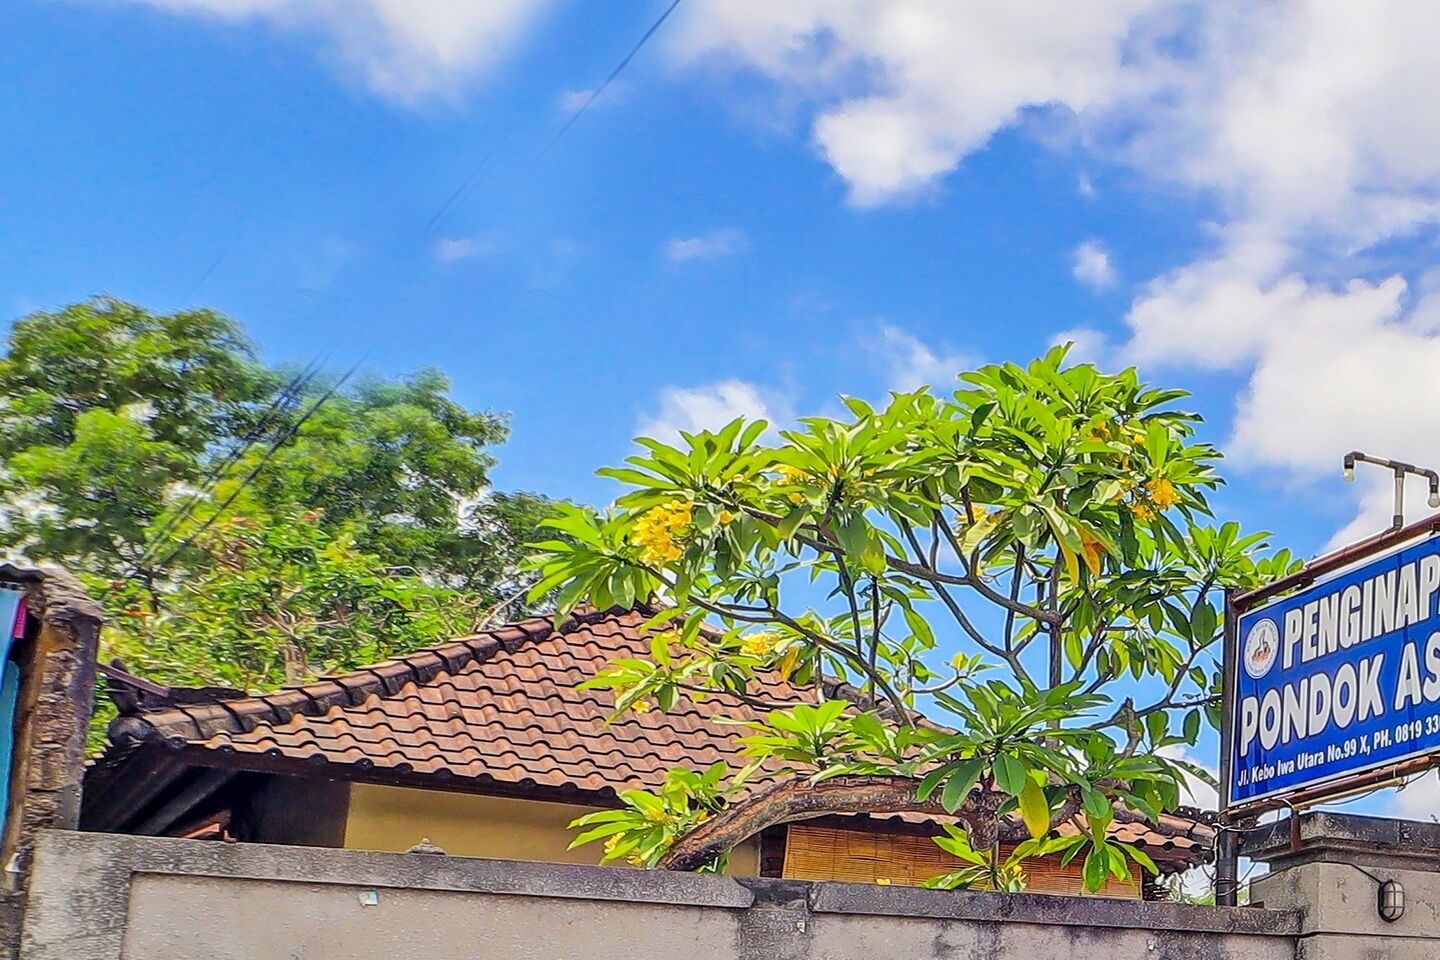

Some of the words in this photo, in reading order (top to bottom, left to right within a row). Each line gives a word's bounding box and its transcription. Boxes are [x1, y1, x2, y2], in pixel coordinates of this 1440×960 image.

[1240, 653, 1384, 757] PONDOK
[1238, 769, 1249, 787] Jl.
[1251, 763, 1275, 784] Kebo
[1277, 759, 1295, 777] Iwa
[1297, 751, 1325, 771] Utara
[1327, 738, 1357, 763] No.99
[1359, 734, 1371, 756] X,
[1373, 728, 1393, 750] PH.
[1395, 720, 1422, 743] 0819
